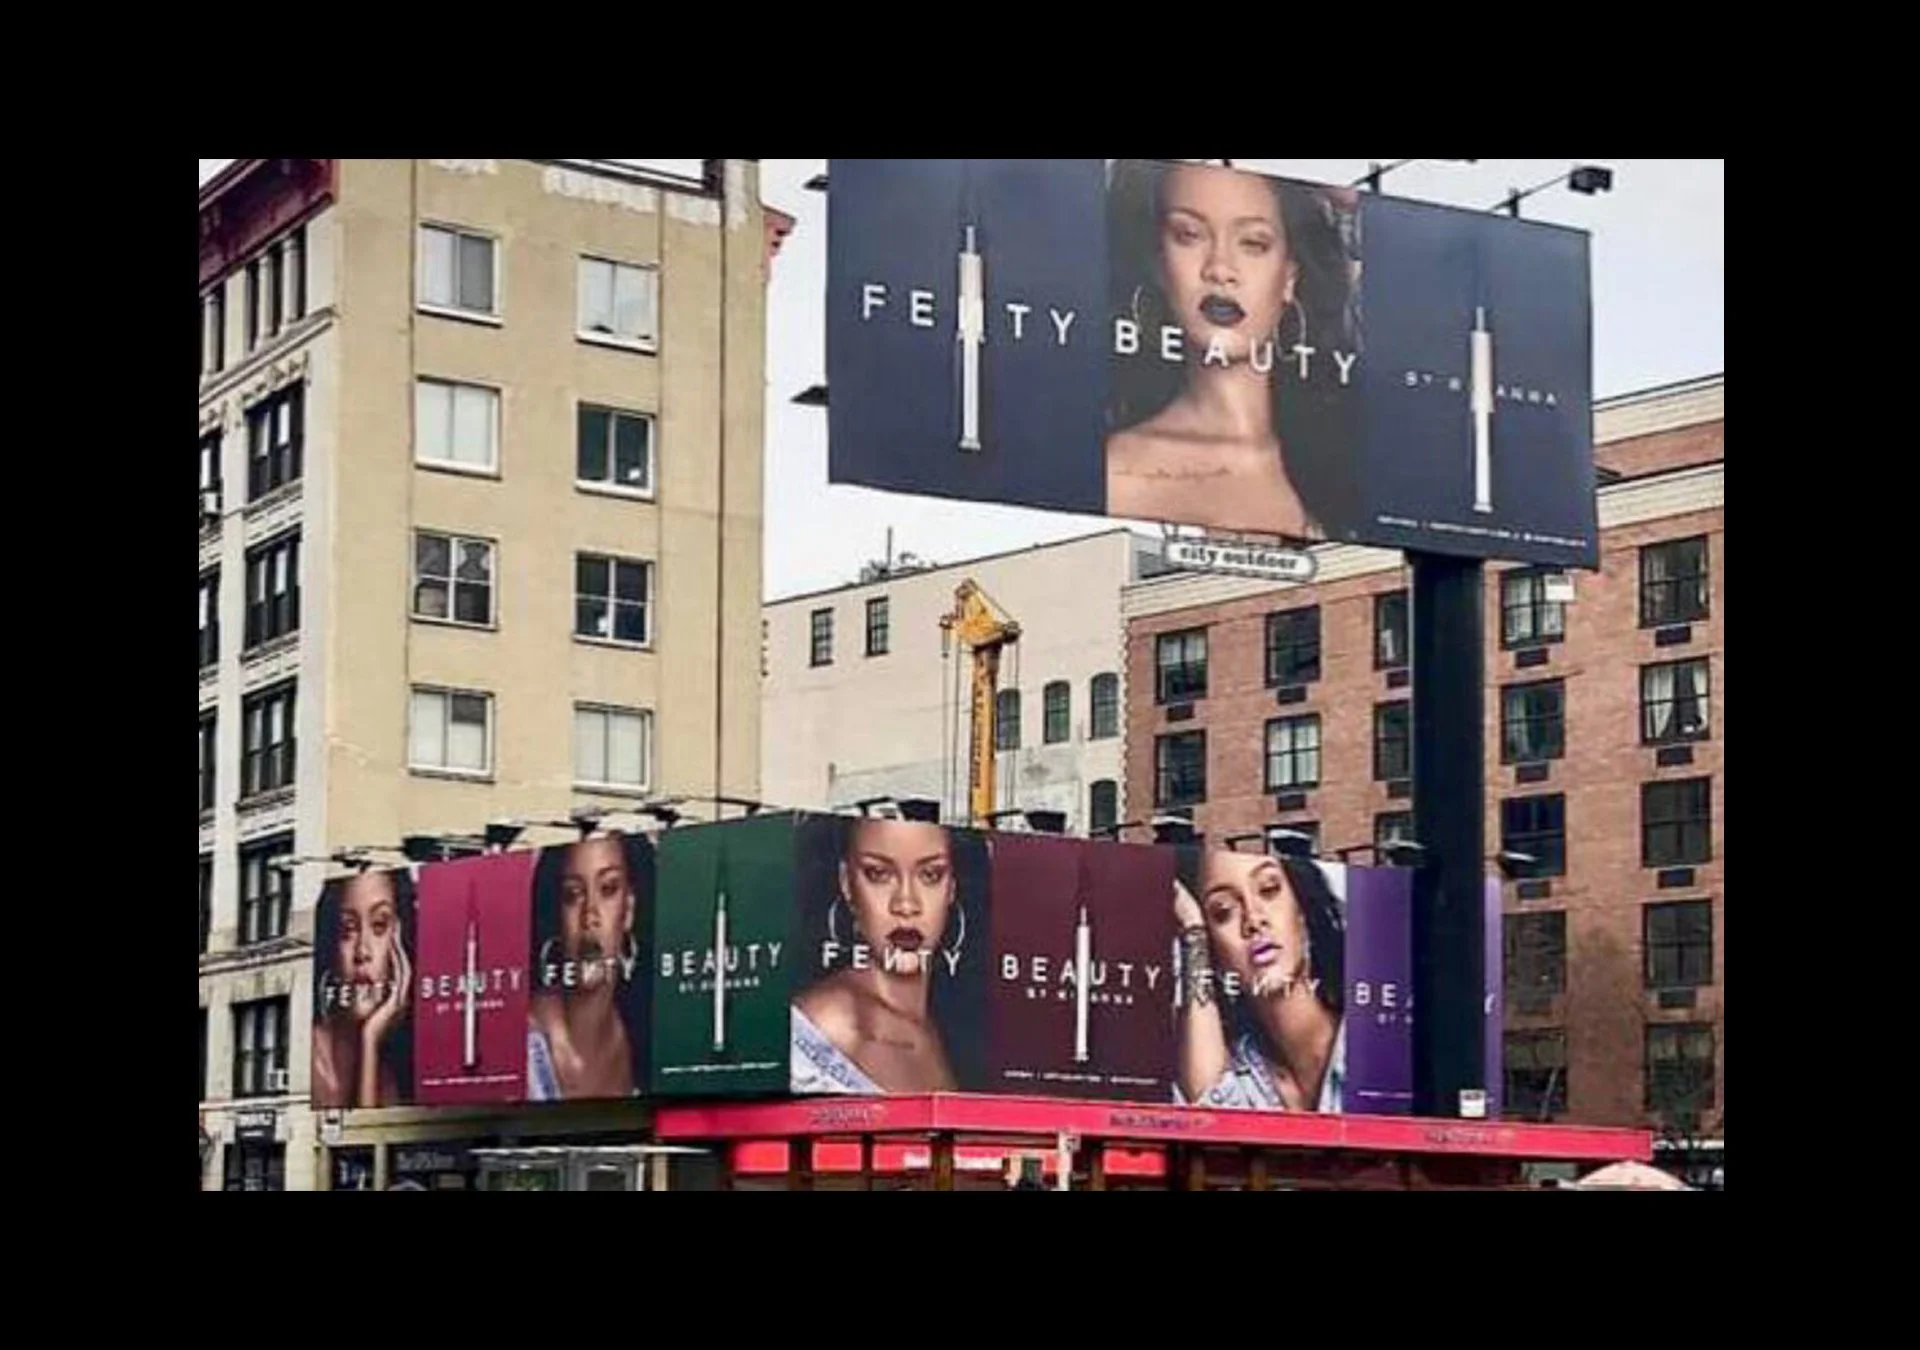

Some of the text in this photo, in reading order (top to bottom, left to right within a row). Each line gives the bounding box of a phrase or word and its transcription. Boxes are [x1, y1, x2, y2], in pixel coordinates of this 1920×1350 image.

[862, 283, 1357, 385] FETY BEAUTY
[1223, 549, 1296, 570] outdoor
[661, 942, 783, 978] BEAUTY
[822, 940, 962, 977] FENTY
[1002, 953, 1162, 991] BEAUTY
[421, 967, 522, 999] BEAUTY
